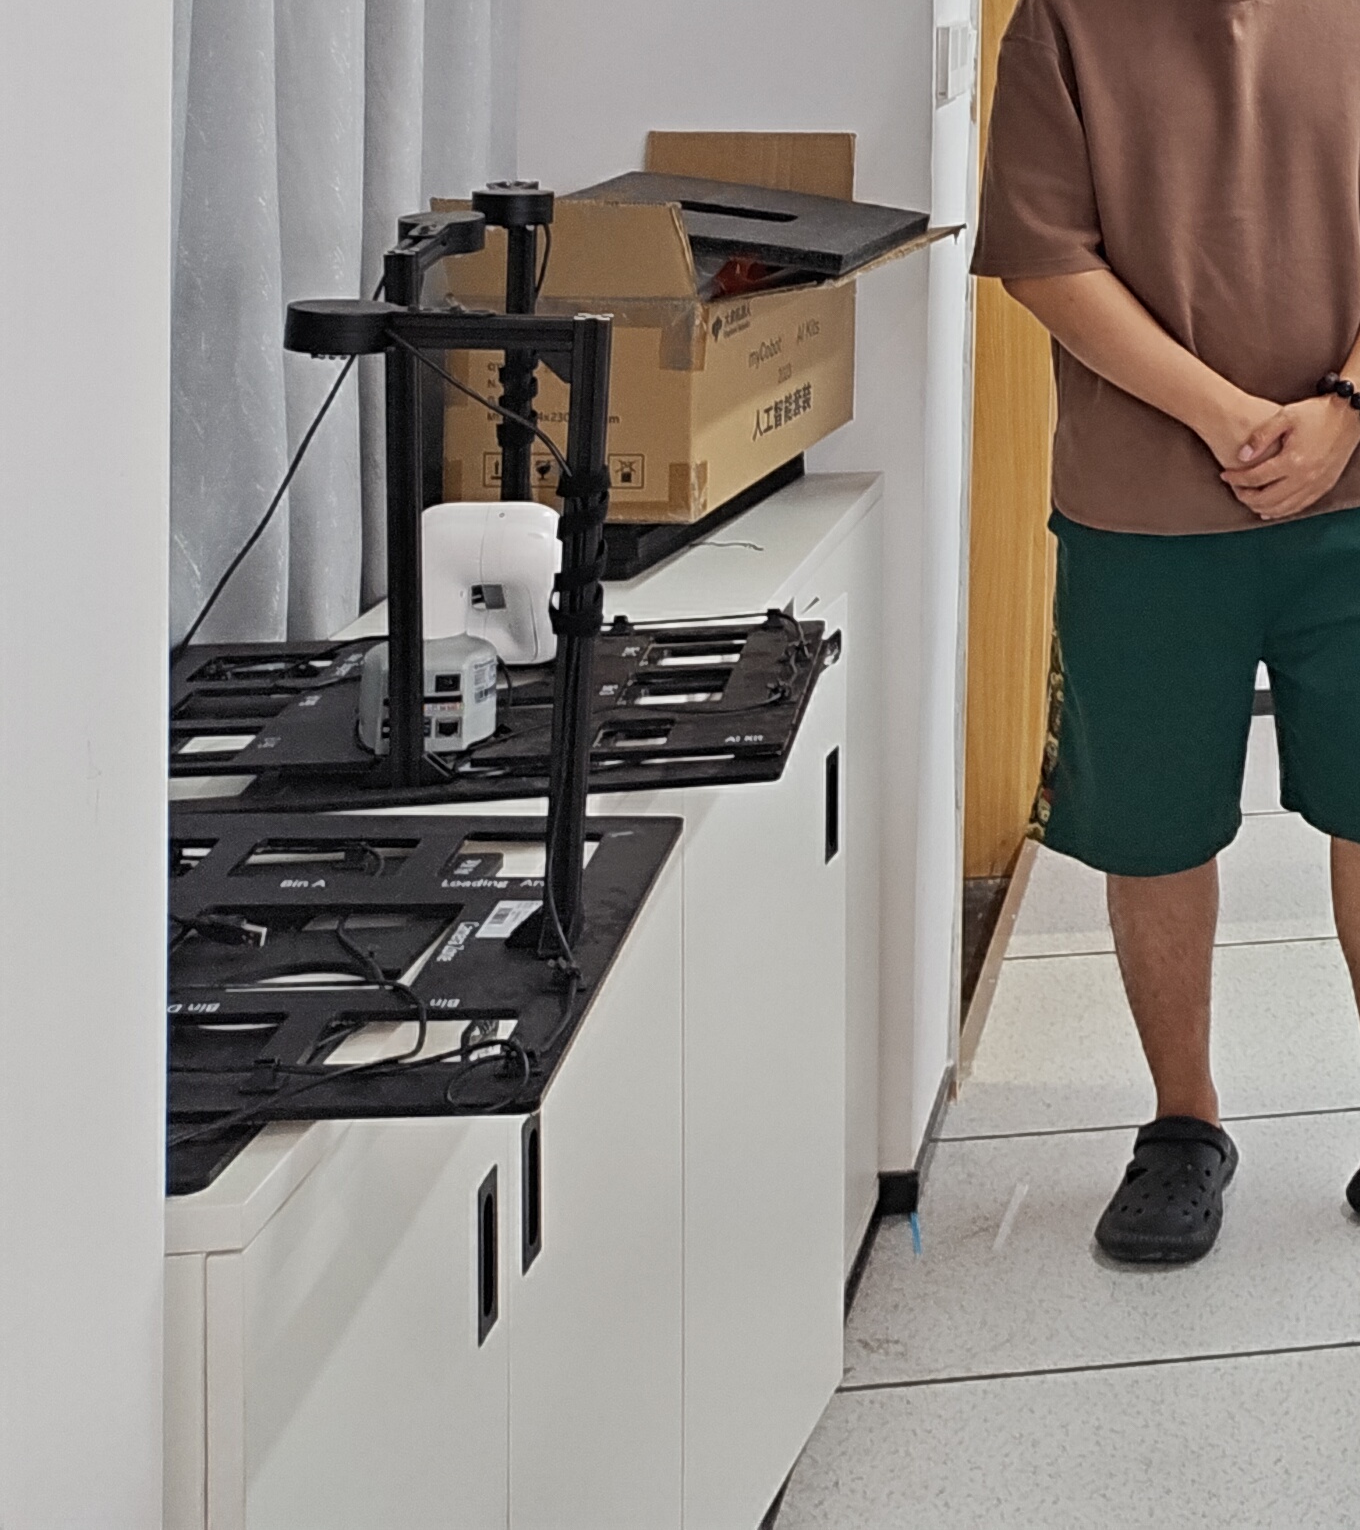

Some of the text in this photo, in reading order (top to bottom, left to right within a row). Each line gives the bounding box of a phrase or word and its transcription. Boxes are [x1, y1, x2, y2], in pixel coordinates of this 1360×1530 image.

[752, 381, 812, 442] 人工智能套装
